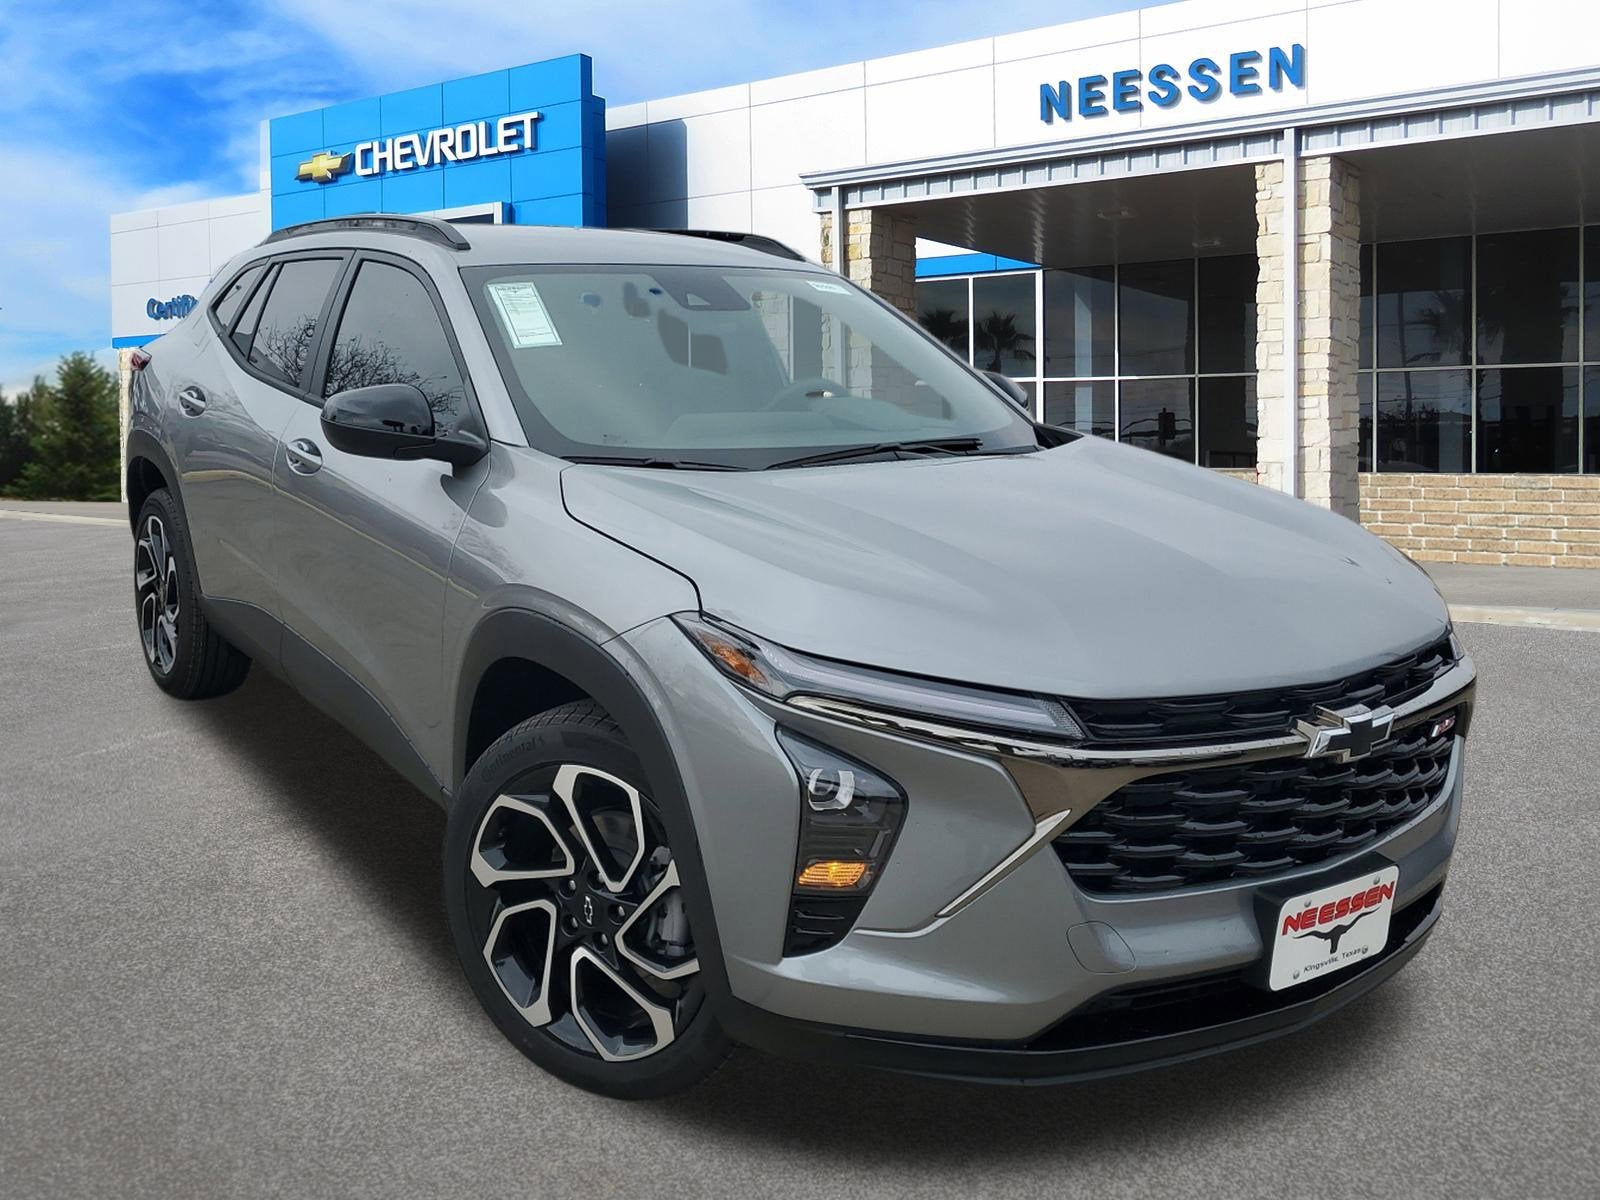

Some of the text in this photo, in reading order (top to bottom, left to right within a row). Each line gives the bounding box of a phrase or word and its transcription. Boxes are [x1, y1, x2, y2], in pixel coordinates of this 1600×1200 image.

[1040, 44, 1305, 124] NEESSEN
[354, 111, 542, 178] CHEVROLET
[1282, 881, 1395, 936] NEESSEN
